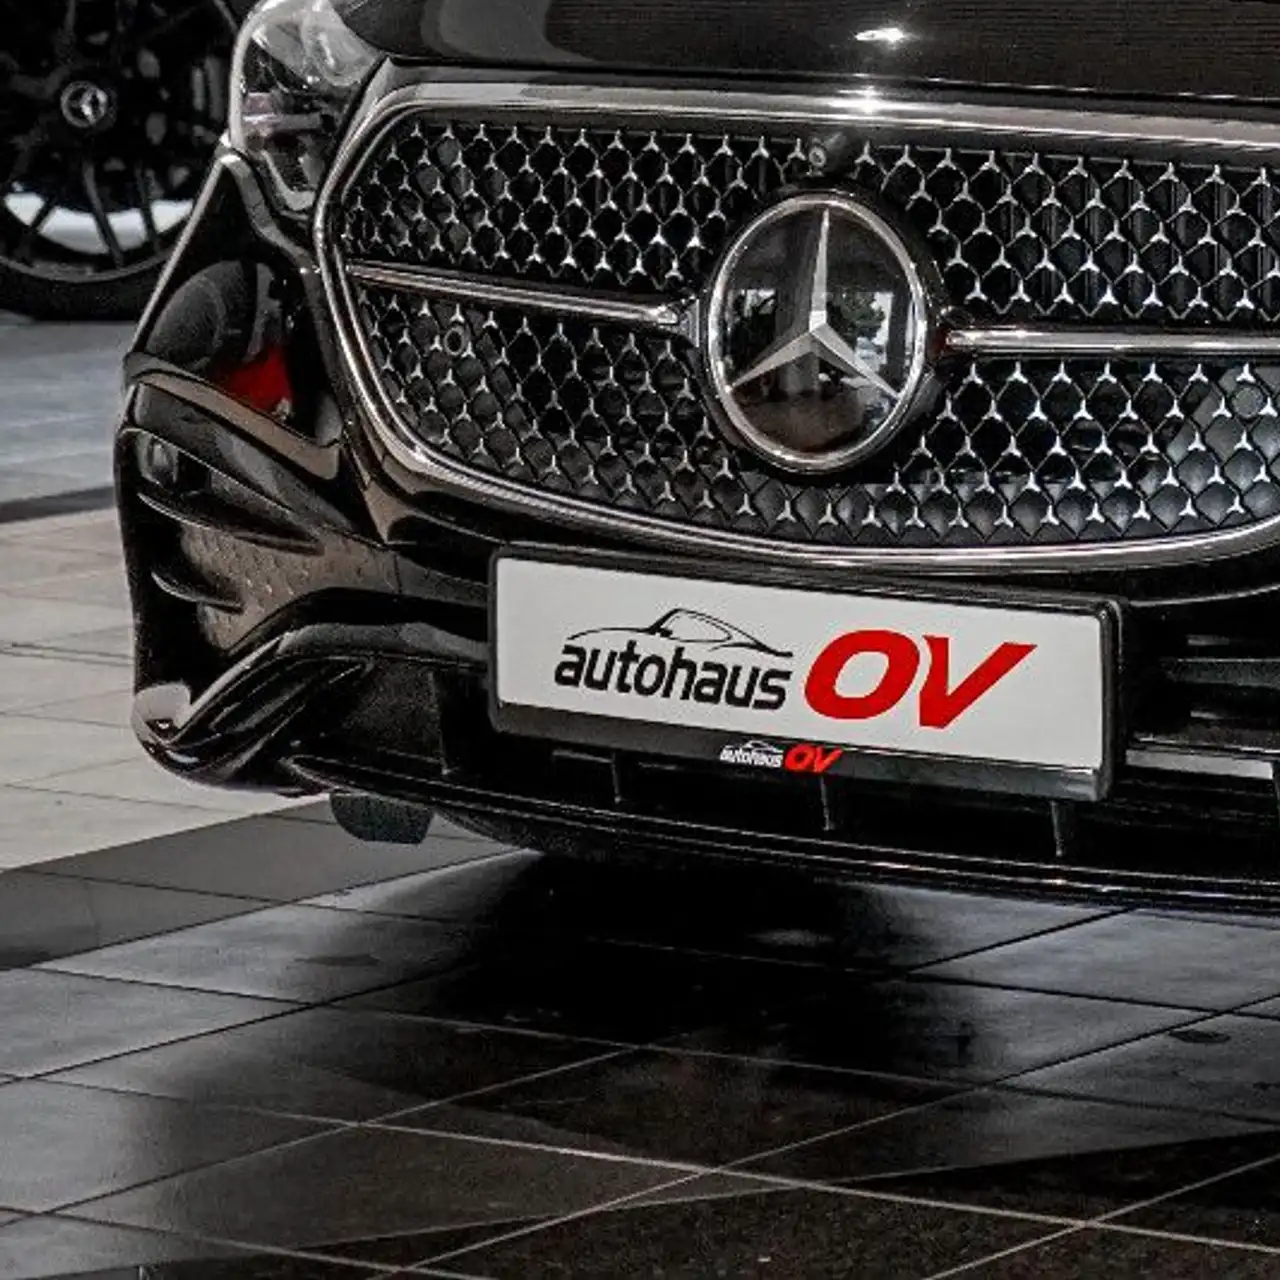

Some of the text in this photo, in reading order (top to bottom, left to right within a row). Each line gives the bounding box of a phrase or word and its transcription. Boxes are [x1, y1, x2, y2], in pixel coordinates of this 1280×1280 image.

[553, 628, 1036, 730] autohaus OV
[719, 742, 843, 774] autohaus OV
